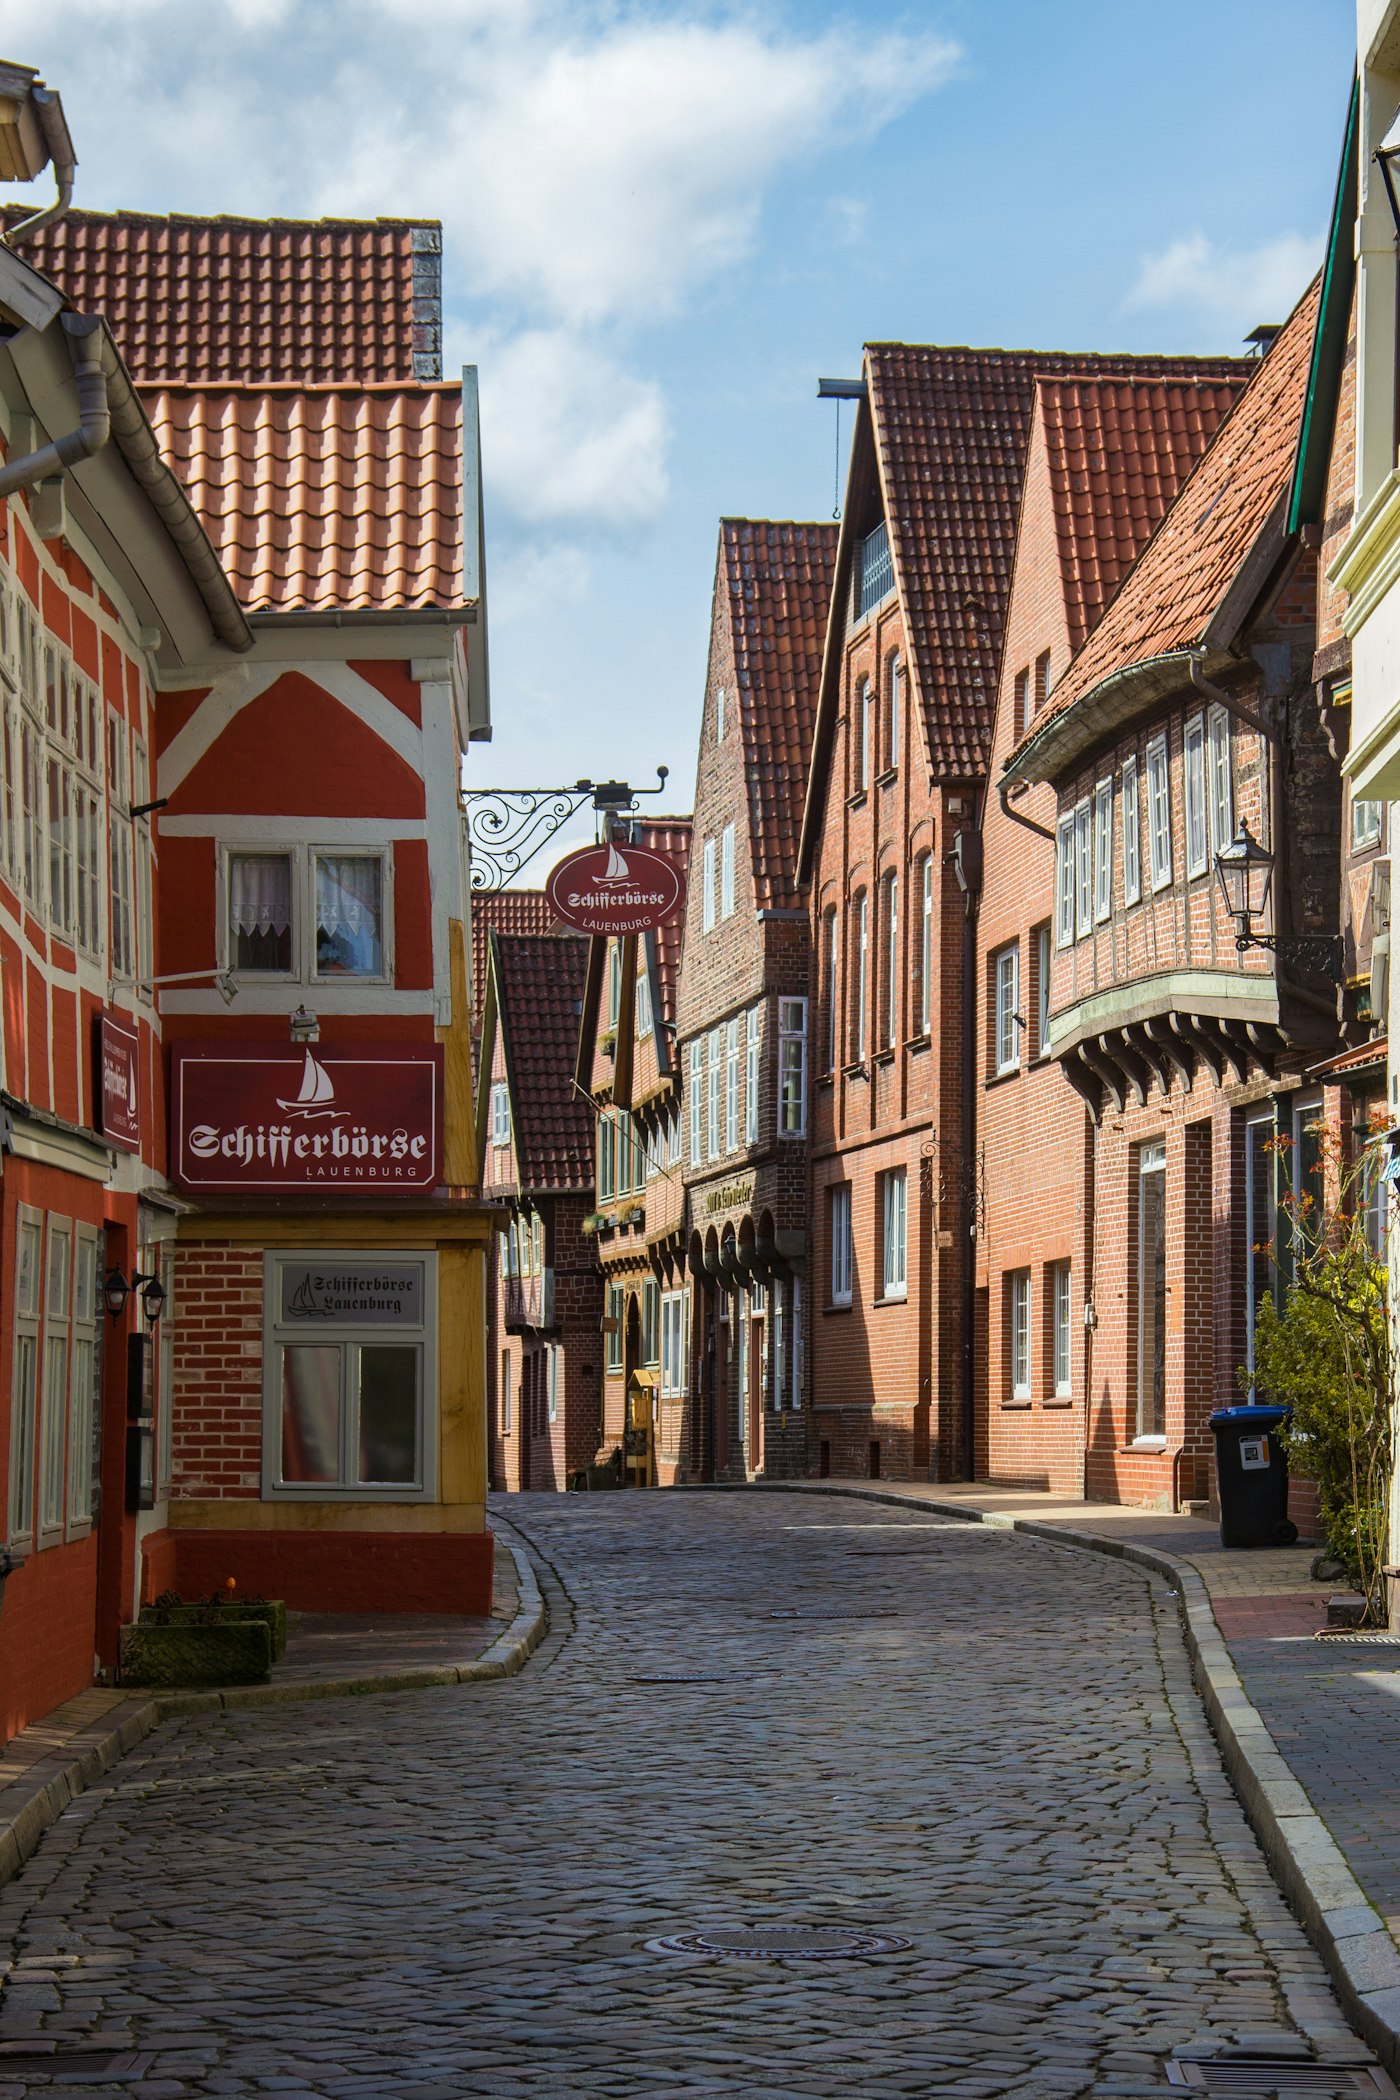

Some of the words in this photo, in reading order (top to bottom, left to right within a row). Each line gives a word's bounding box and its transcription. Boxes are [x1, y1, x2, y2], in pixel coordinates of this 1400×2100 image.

[567, 891, 665, 910] Schifferbörse
[582, 915, 652, 931] LAUENBURG
[188, 1125, 427, 1168] Schifferbörse
[306, 1166, 416, 1177] LAUENBURG
[313, 1276, 413, 1293] Schifferbörse
[324, 1295, 402, 1314] Lauenburg
